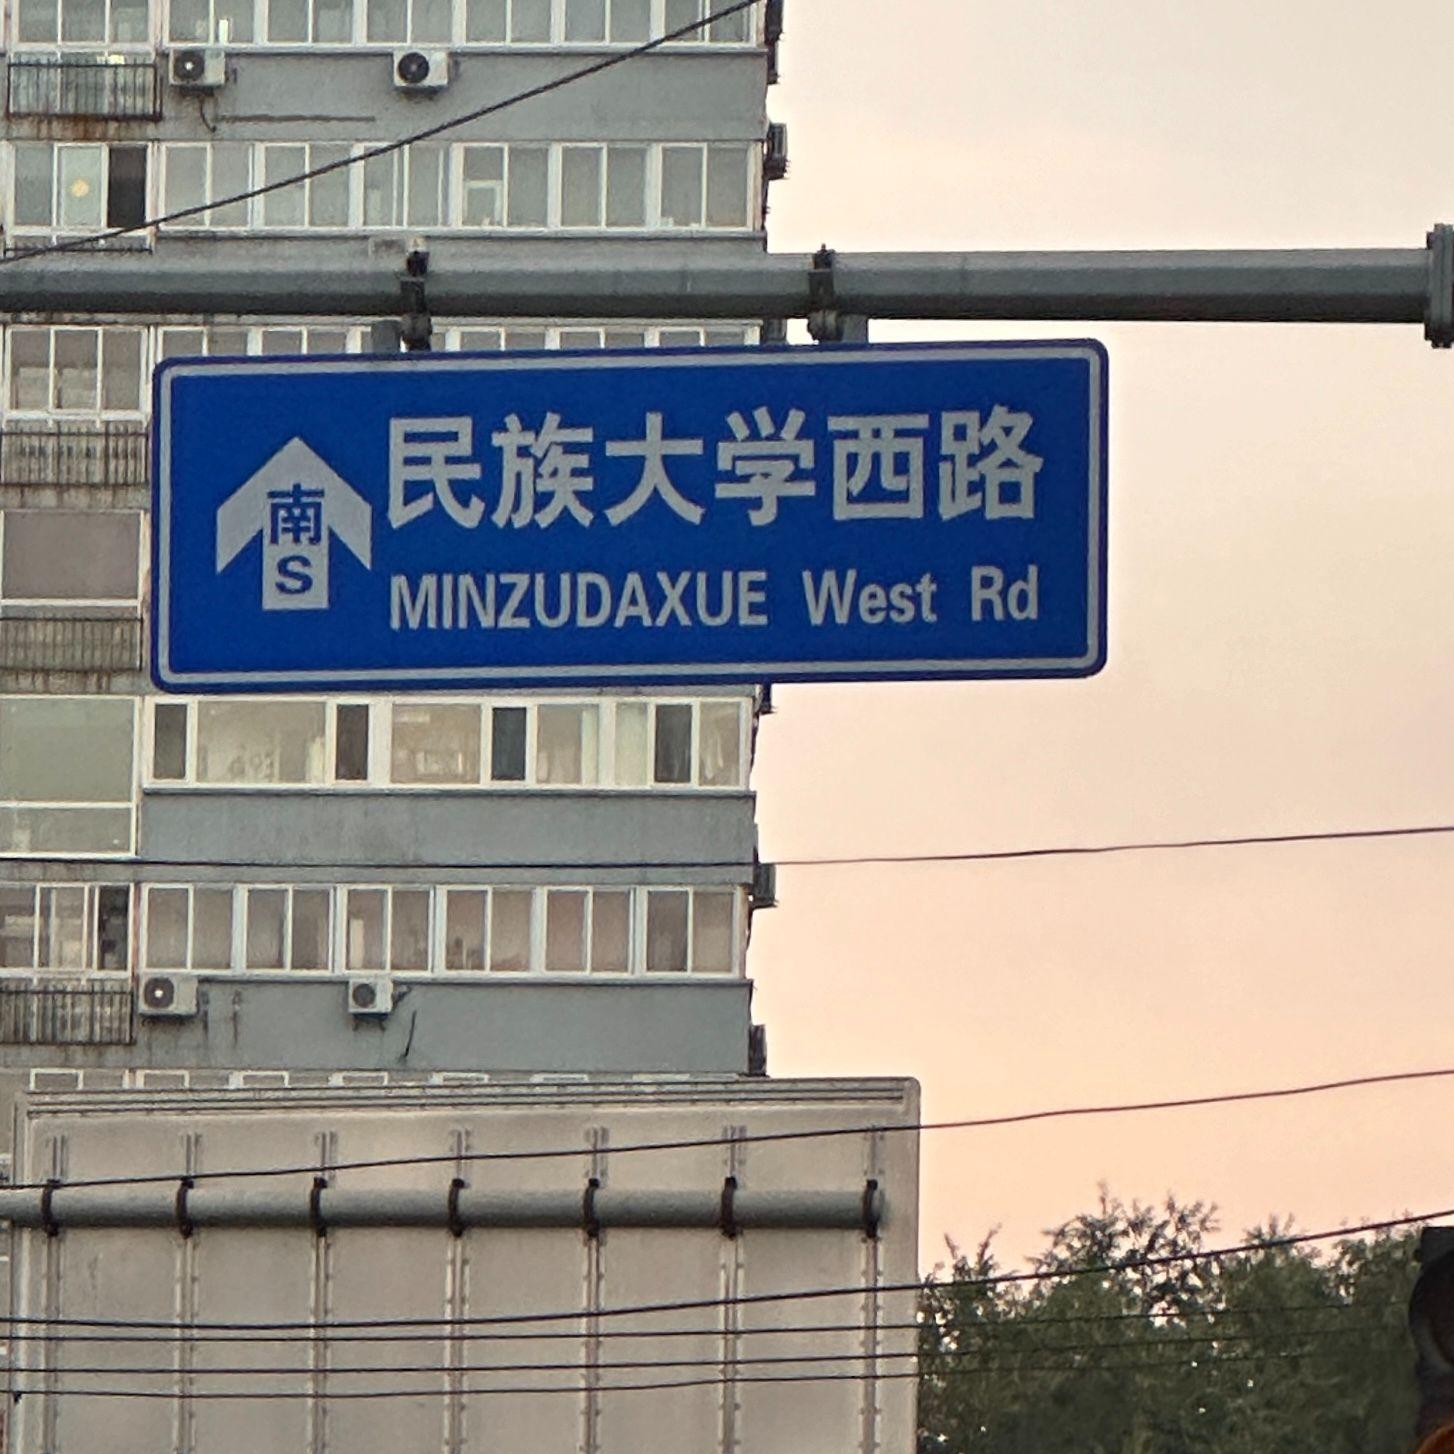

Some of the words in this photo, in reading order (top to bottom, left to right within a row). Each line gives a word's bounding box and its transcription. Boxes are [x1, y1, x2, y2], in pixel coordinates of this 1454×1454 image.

[387, 404, 1044, 530] 民族大学西路
[267, 483, 325, 545] 南
[275, 555, 313, 594] S
[390, 570, 769, 630] MINZUDAXUE
[803, 568, 938, 625] West
[971, 564, 1039, 623] Rd
